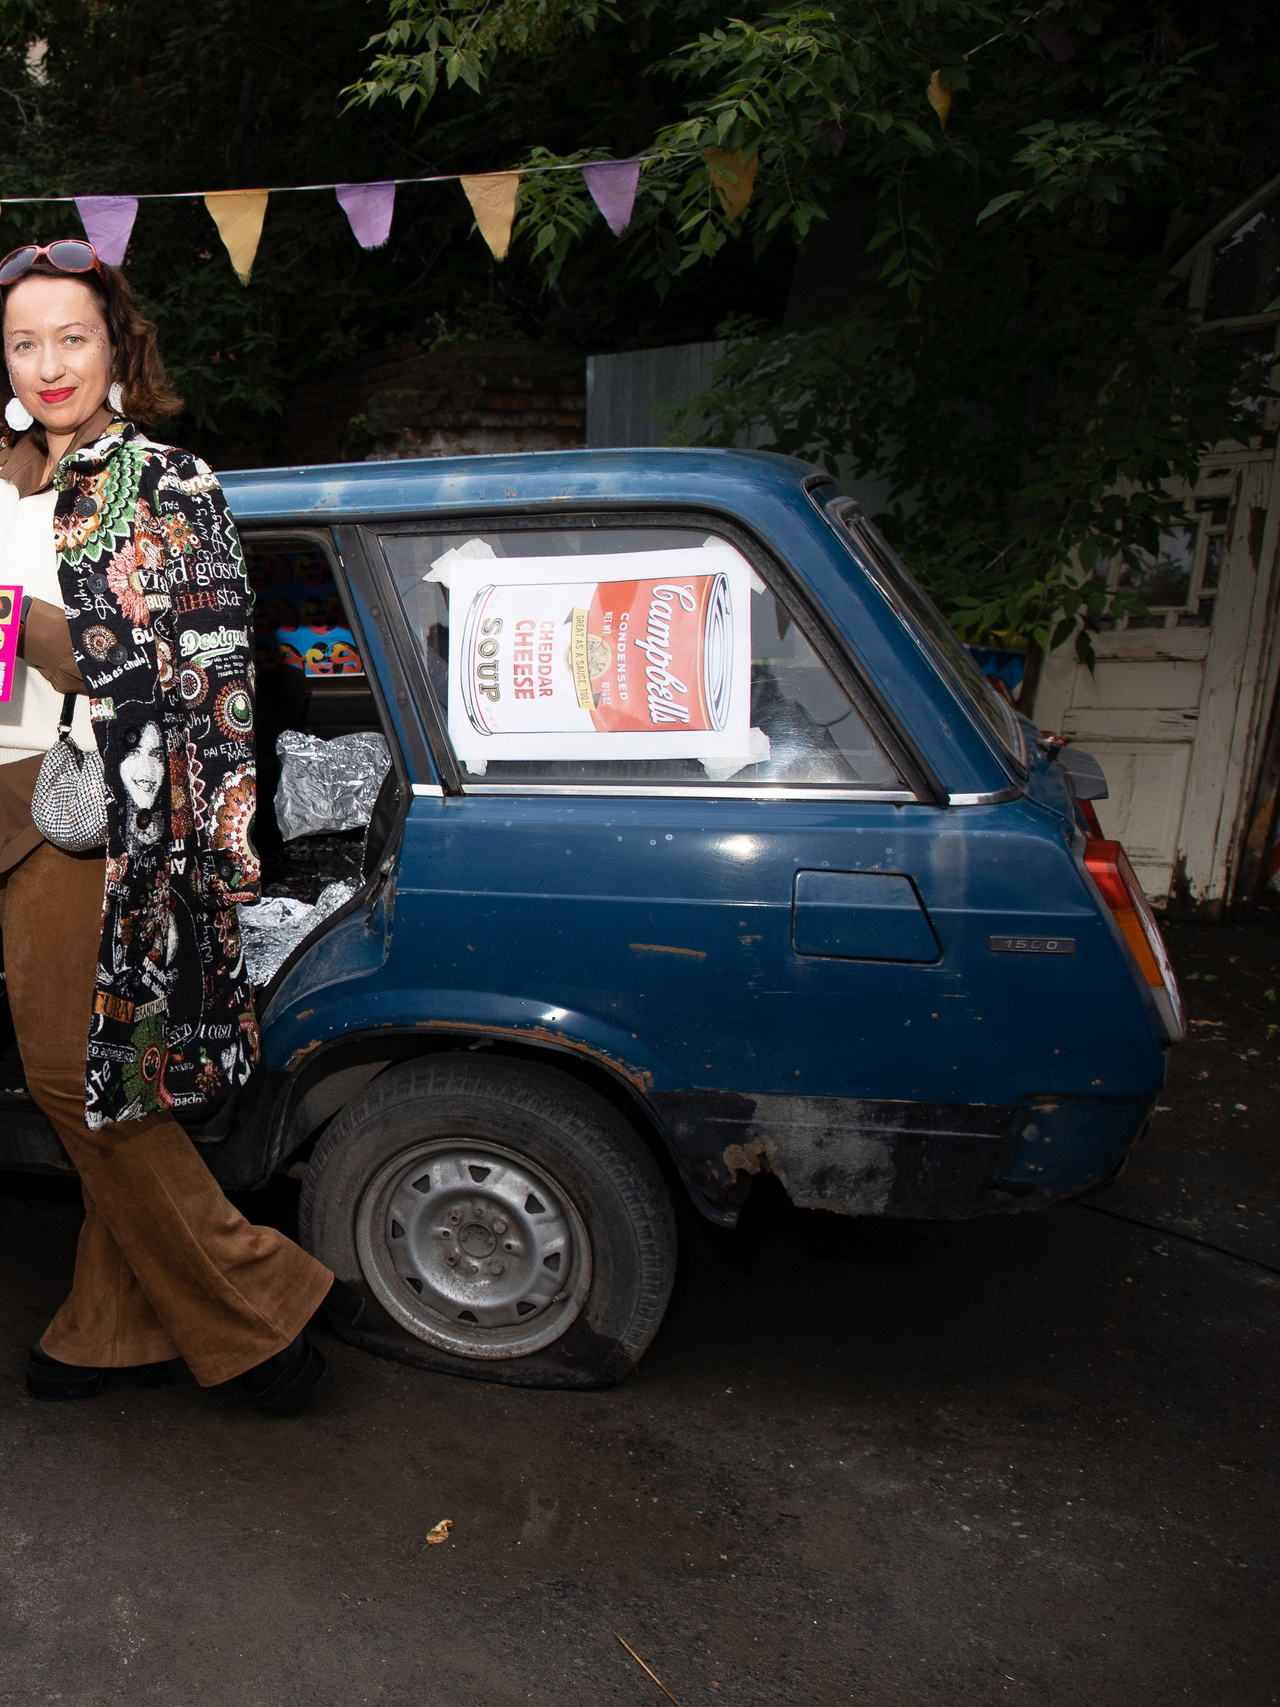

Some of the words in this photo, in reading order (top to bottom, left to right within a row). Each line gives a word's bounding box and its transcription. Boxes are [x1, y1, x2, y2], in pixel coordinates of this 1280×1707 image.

[575, 614, 586, 637] GREAT
[575, 639, 585, 650] AS
[604, 611, 613, 623] NET
[634, 584, 697, 725] Campbell's
[476, 617, 504, 703] SOUP
[513, 619, 536, 700] CHEESE
[537, 620, 555, 697] CHEDDAR
[576, 660, 587, 687] SAUCE,
[616, 612, 630, 701] CONDENSED
